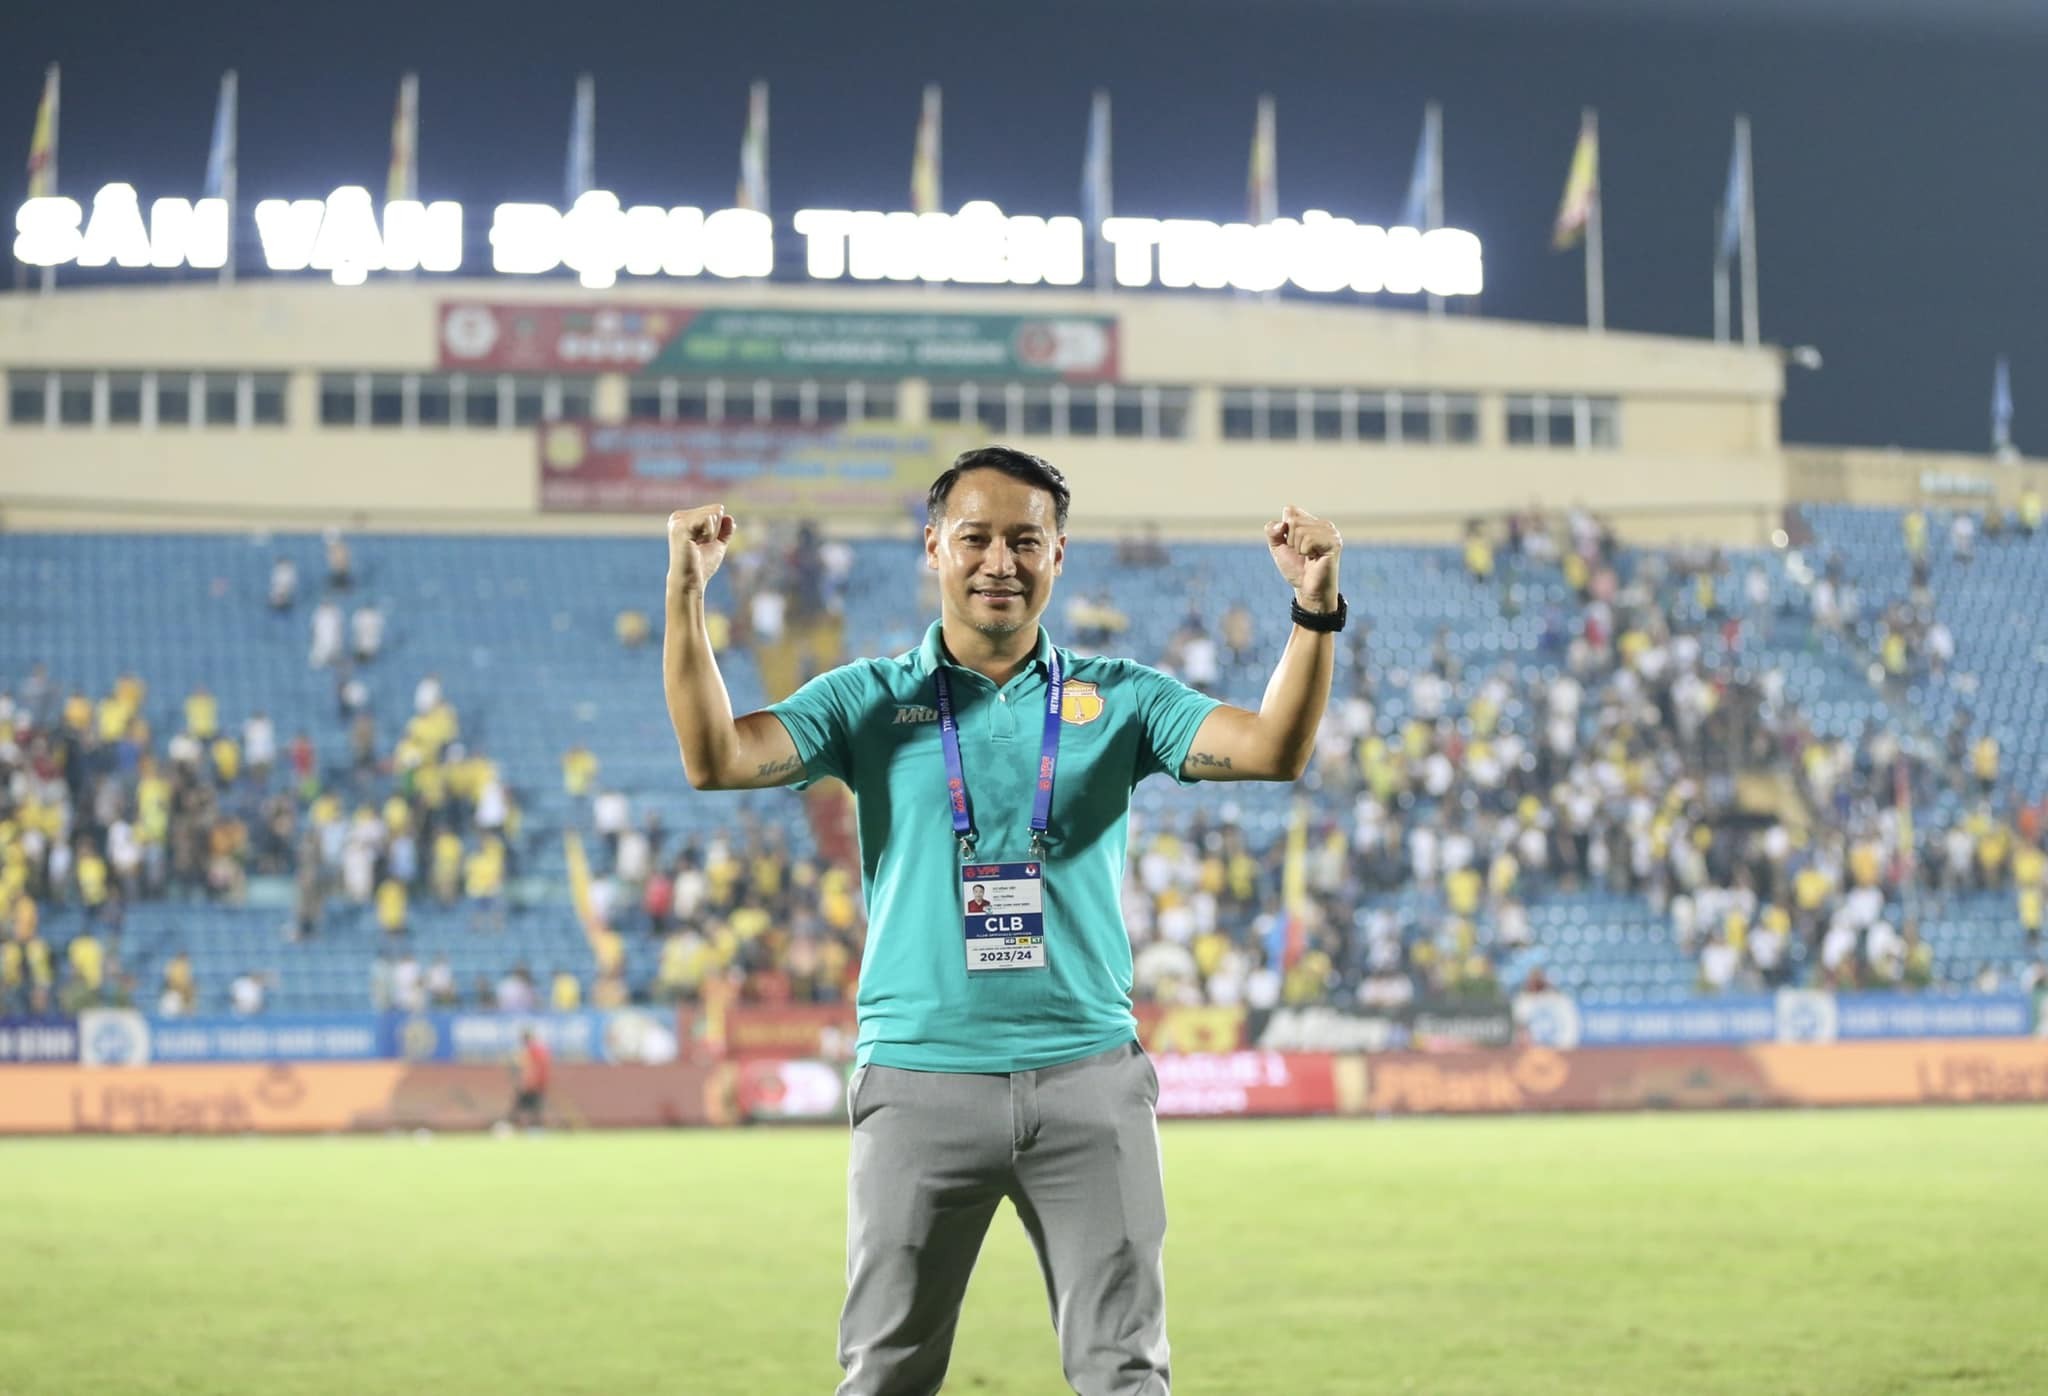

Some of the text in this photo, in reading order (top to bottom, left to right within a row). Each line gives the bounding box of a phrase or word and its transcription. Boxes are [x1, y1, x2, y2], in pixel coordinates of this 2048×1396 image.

[14, 184, 229, 268] SÂN
[255, 186, 462, 285] VẬN
[490, 190, 773, 288] ĐỘNG
[795, 201, 1083, 285] THIÊN
[985, 916, 1024, 932] CLB
[980, 950, 1032, 963] 2023/24
